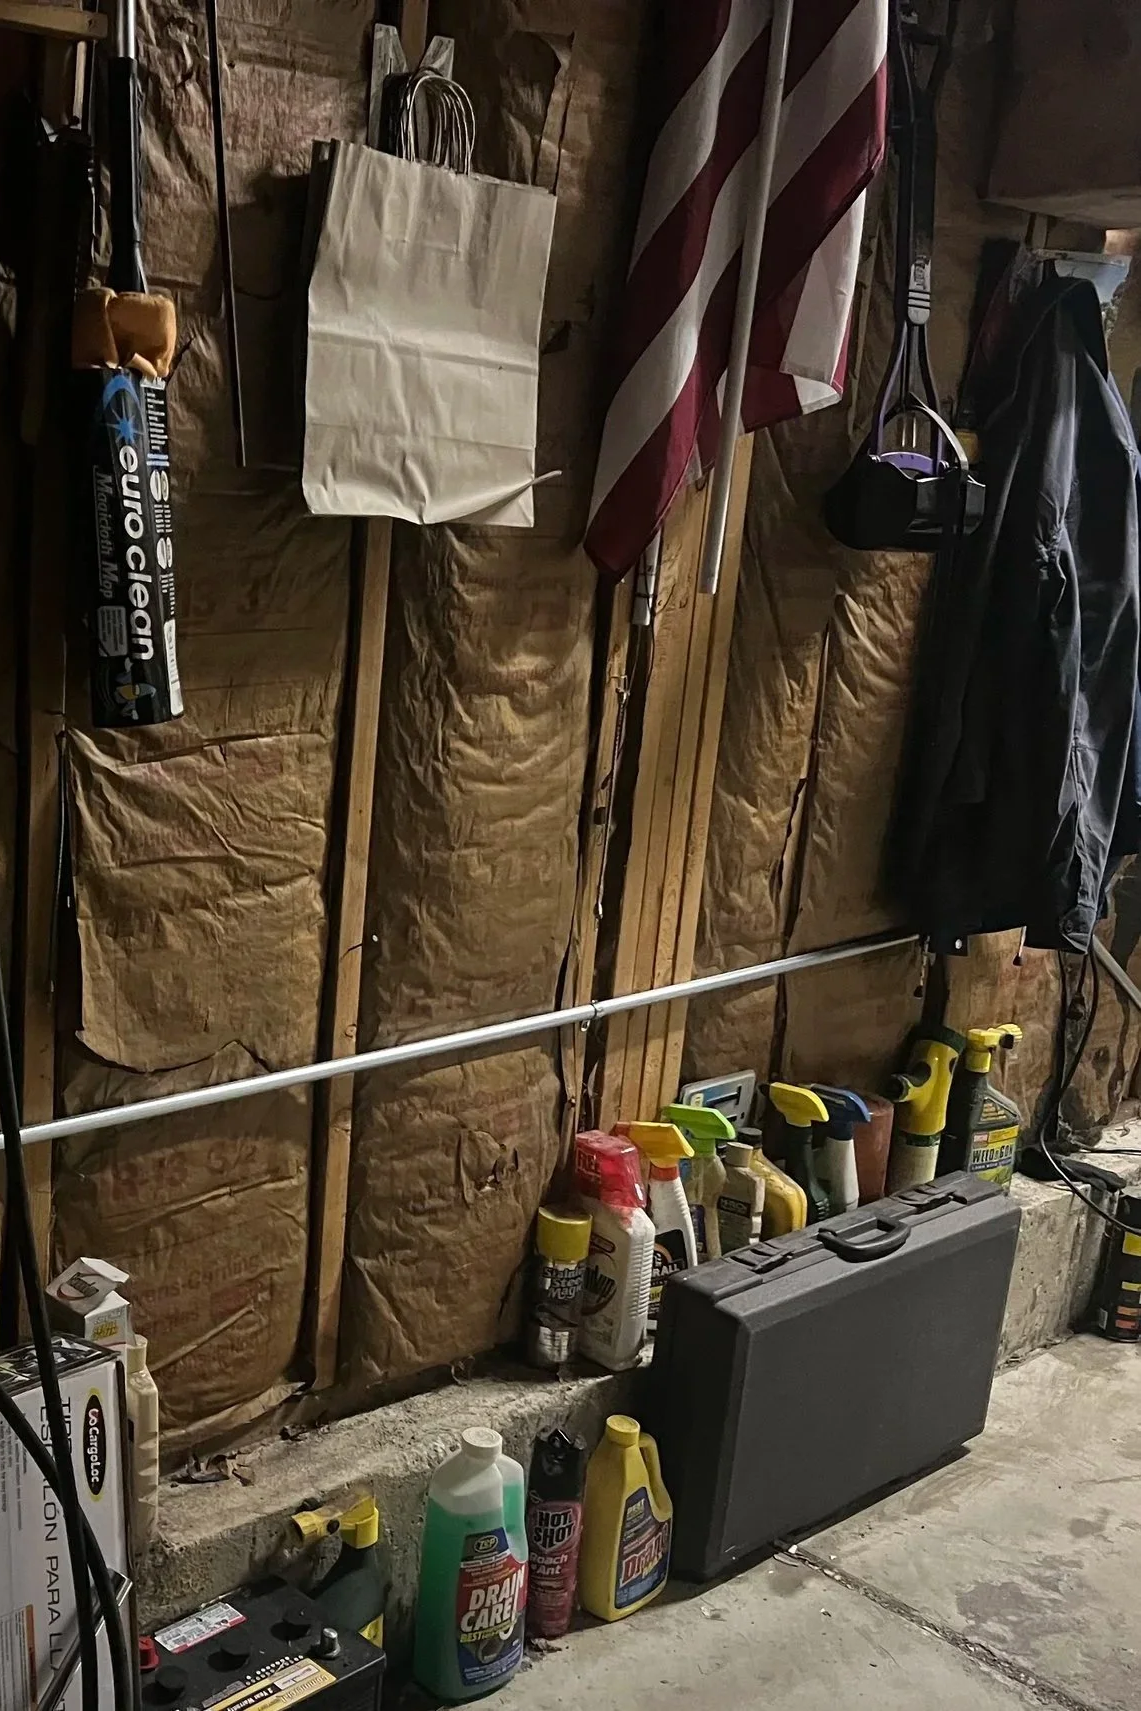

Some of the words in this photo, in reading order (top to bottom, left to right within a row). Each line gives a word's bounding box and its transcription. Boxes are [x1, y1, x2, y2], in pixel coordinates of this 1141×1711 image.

[118, 445, 145, 541] euro
[98, 560, 120, 600] Mop
[125, 544, 155, 661] clean
[86, 1425, 101, 1484] CargoLoc
[533, 1523, 576, 1550] SHOT
[537, 1510, 574, 1528] HOT
[530, 1552, 569, 1566] Roach
[537, 1564, 562, 1577] Ant
[45, 1556, 62, 1626] PARA
[468, 1565, 526, 1612] DRAIN
[459, 1596, 515, 1634] CARE
